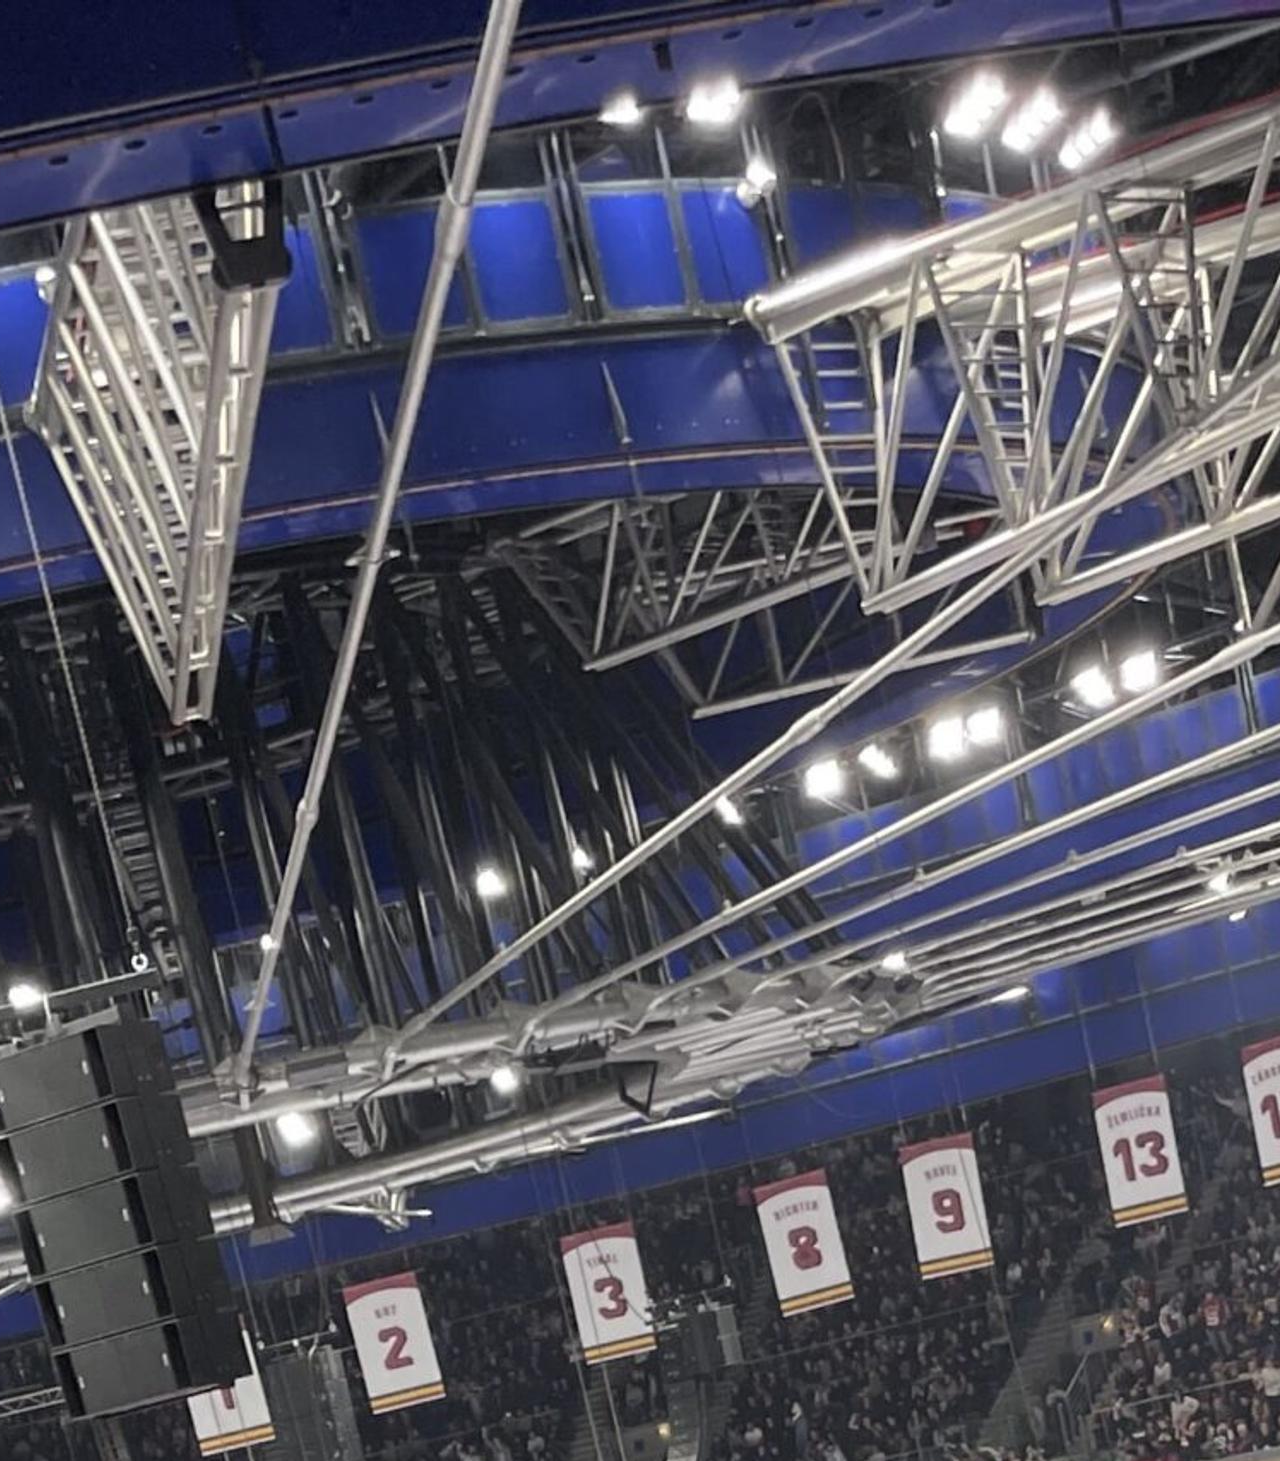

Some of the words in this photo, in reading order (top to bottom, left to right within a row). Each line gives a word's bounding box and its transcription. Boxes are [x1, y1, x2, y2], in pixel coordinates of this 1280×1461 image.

[1113, 1131, 1169, 1182] 13
[931, 1188, 966, 1233] 9
[787, 1226, 823, 1271] 8
[593, 1277, 628, 1319] 3
[378, 1326, 414, 1370] 2
